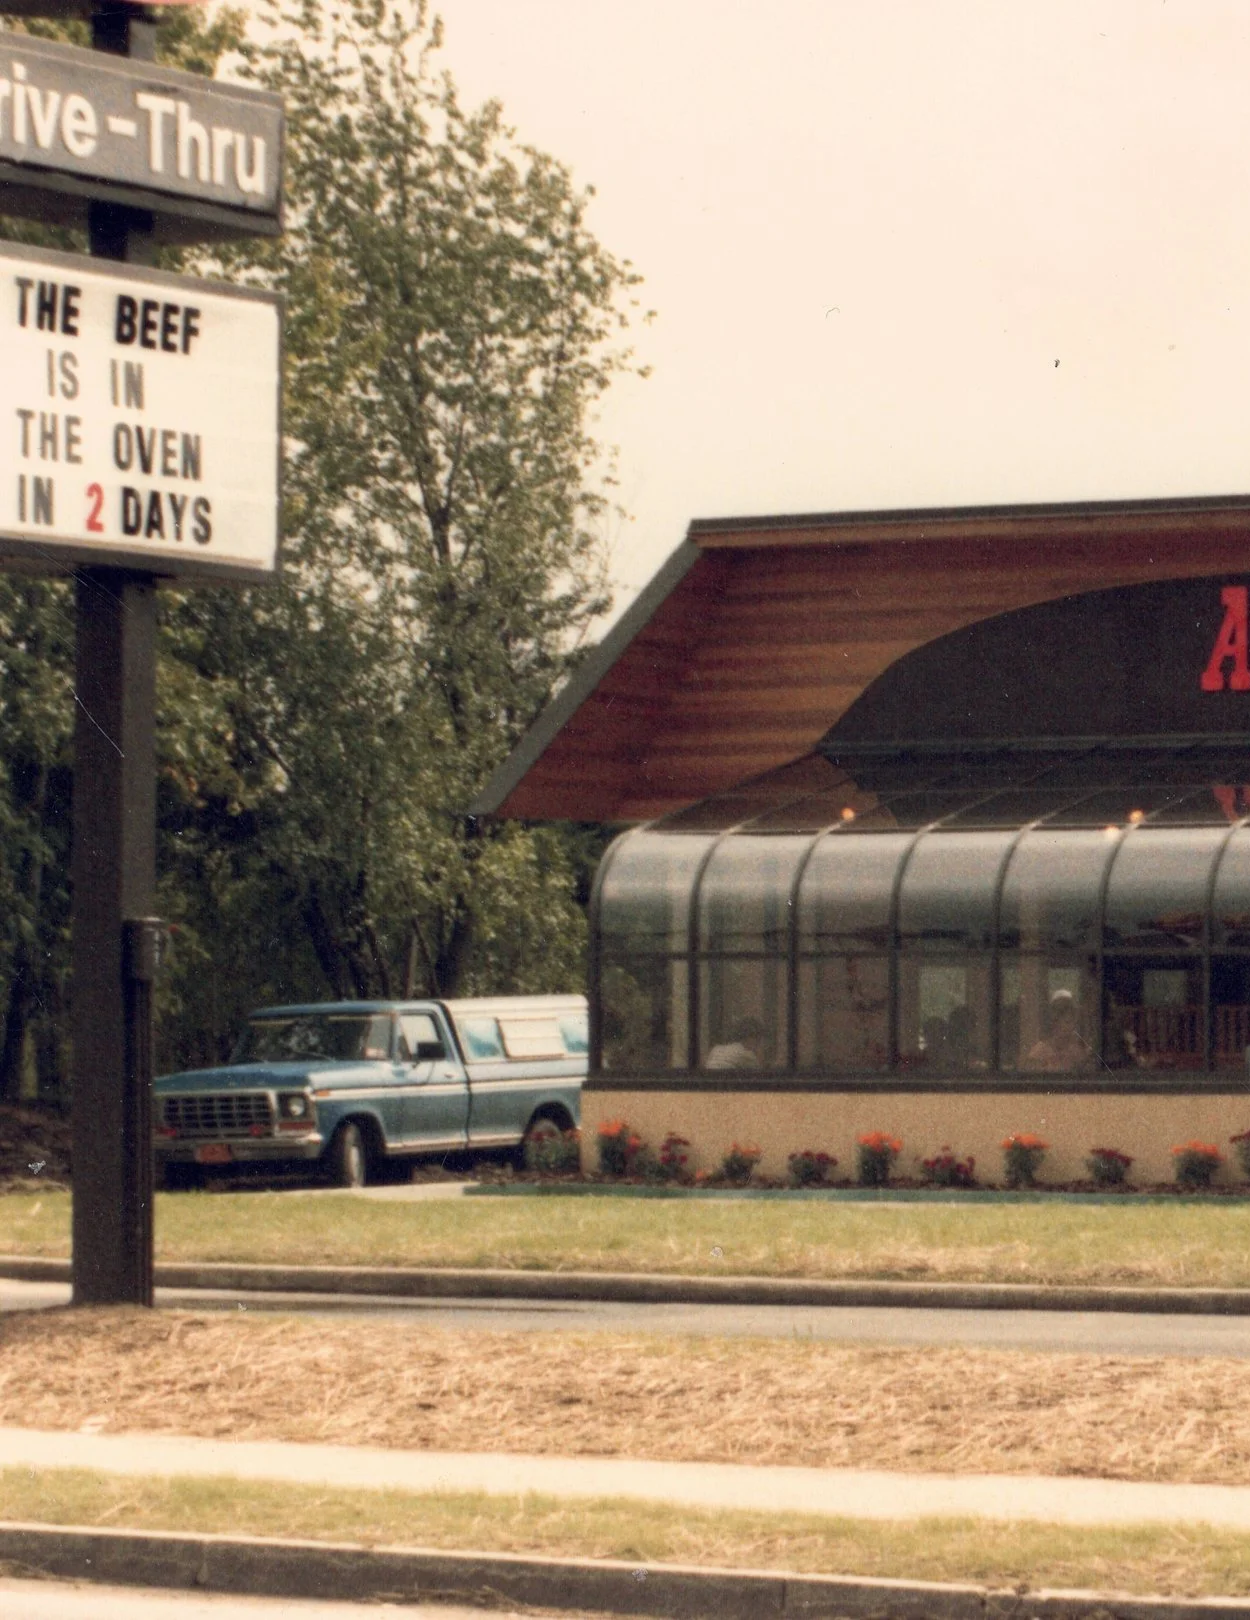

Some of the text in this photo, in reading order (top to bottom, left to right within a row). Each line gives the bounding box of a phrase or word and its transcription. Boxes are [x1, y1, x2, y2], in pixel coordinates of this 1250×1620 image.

[15, 276, 201, 355] THE BEEF
[47, 348, 144, 411] IS IN
[16, 408, 202, 481] THE OVEN
[18, 474, 212, 545] IN 2 DAYS
